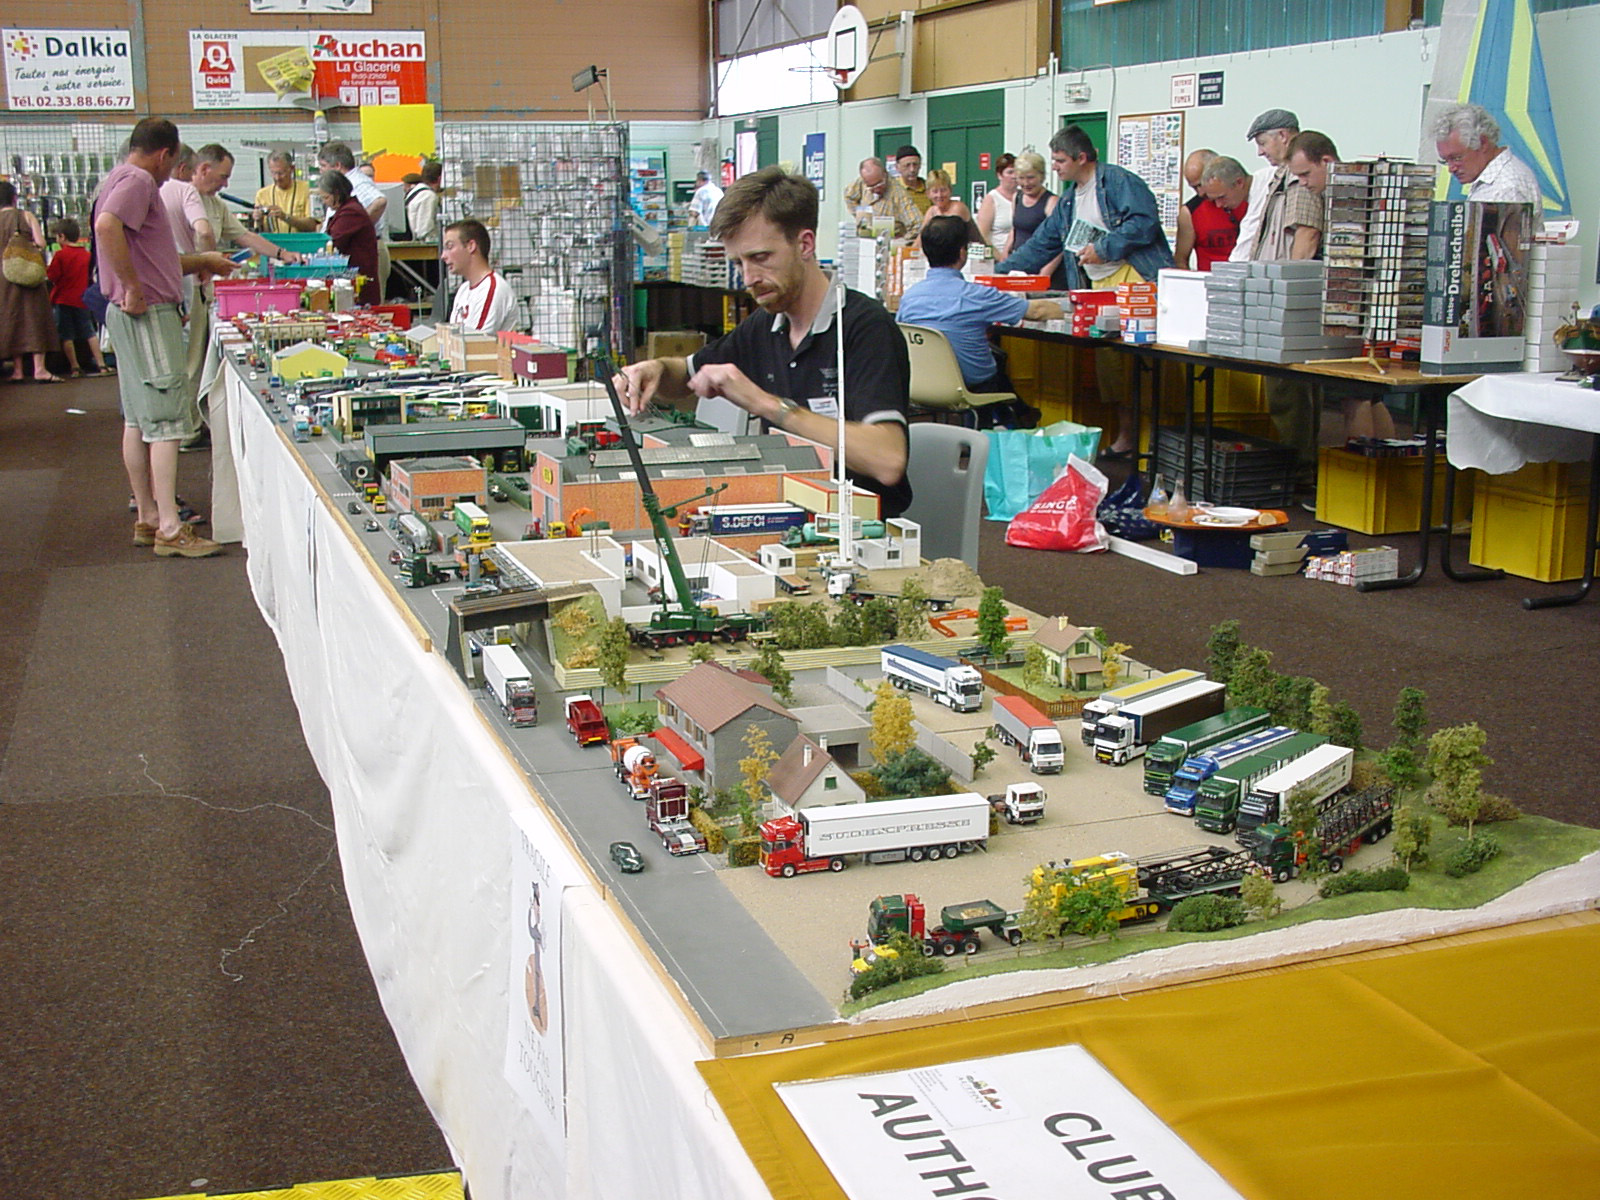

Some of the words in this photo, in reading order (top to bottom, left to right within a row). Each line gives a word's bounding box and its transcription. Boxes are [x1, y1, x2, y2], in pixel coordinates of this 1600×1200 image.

[45, 36, 127, 57] Dalkia
[313, 35, 423, 57] Auchan
[206, 45, 230, 70] Q
[336, 61, 351, 73] La
[353, 61, 401, 73] Glacerie
[15, 67, 46, 80] Toutes
[52, 69, 69, 78] nos
[75, 64, 116, 79] énergies
[207, 76, 230, 84] Quick
[42, 82, 50, 92] à
[55, 80, 82, 91] votre
[520, 829, 551, 889] FRAGILE
[858, 1092, 1000, 1200] AUTH
